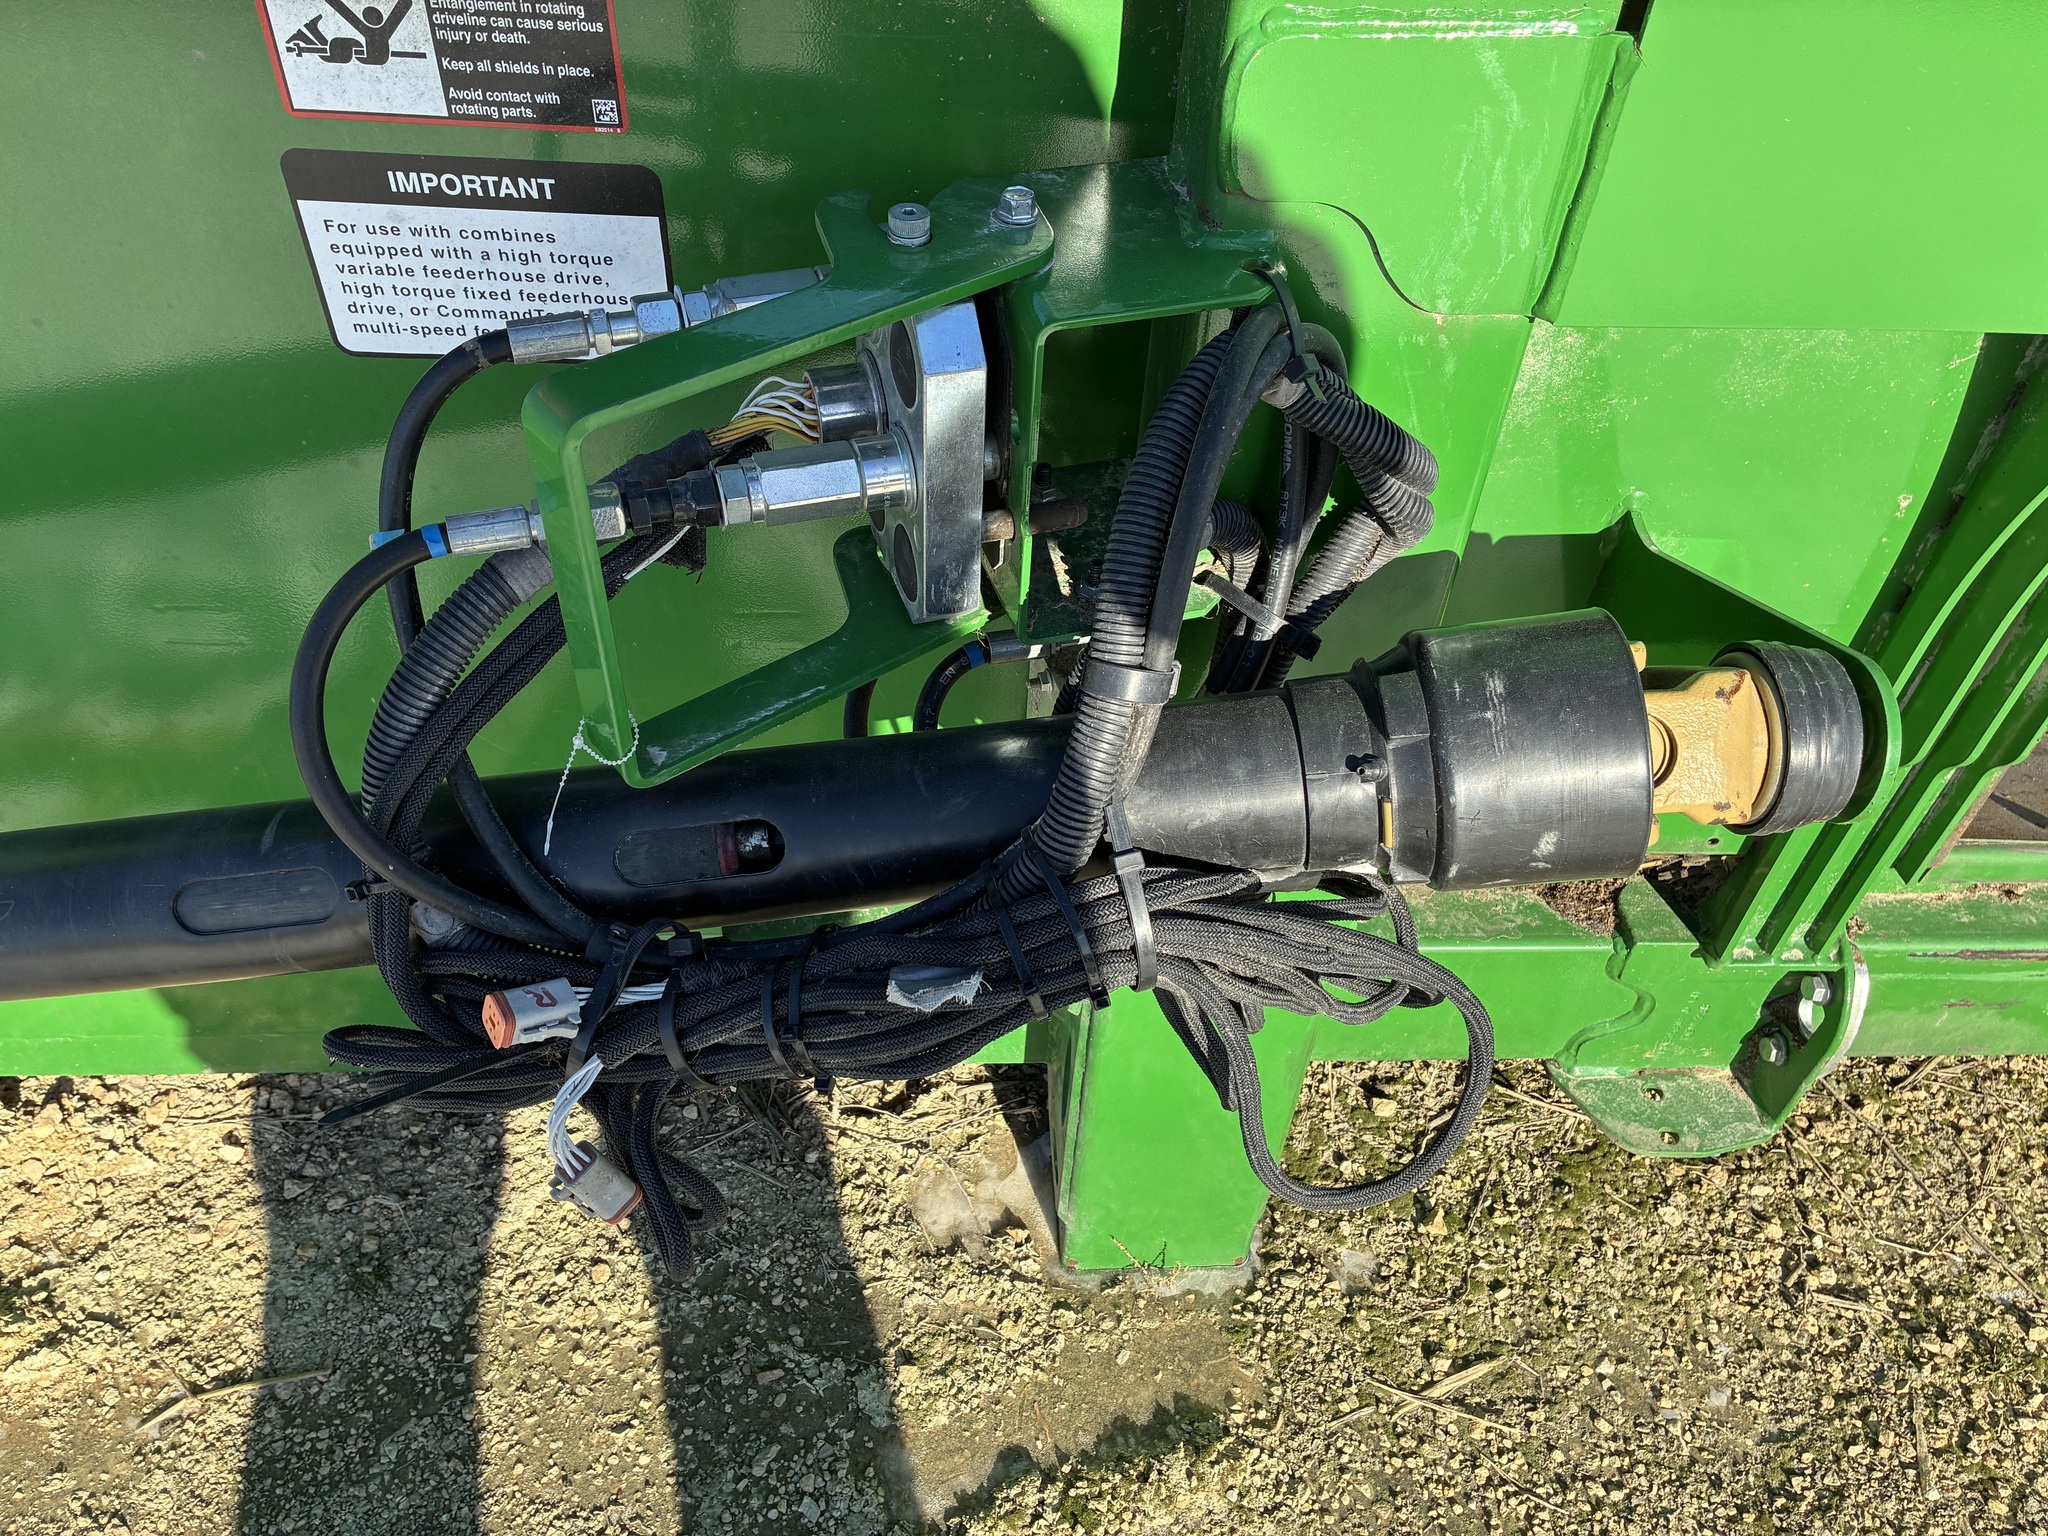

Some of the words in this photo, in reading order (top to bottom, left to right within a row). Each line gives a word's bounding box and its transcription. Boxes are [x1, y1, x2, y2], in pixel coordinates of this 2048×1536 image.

[430, 0, 517, 13] Entanglement
[520, 1, 532, 13] in
[536, 3, 585, 18] rotating
[433, 11, 487, 26] driveline
[490, 17, 513, 28] can
[516, 18, 554, 30] cause
[557, 19, 604, 33] serious
[435, 27, 472, 44] injury
[474, 32, 488, 42] or
[491, 29, 531, 44] death.
[441, 56, 474, 73] Keep
[476, 59, 491, 72] all
[495, 60, 540, 75] shields
[542, 63, 554, 75] in
[557, 64, 595, 79] place.
[449, 86, 482, 100] Avoid
[486, 91, 532, 103] contact
[534, 92, 561, 105] with
[451, 103, 499, 118] rotating
[502, 105, 537, 120] parts.
[386, 170, 556, 200] IMPORTANT
[323, 219, 357, 234] For
[365, 224, 401, 236] use
[408, 224, 451, 239] with
[459, 227, 556, 244] combines
[329, 242, 423, 260] equipped
[430, 246, 473, 260] with
[480, 250, 491, 261] a
[498, 249, 542, 266] high
[549, 251, 614, 268] torque
[335, 262, 416, 277] variable
[422, 265, 546, 283] feederhouse
[554, 271, 610, 287] drive,
[340, 281, 385, 298] high
[391, 284, 456, 301] torque
[462, 286, 512, 301] fixed
[518, 289, 628, 306] feederhous
[347, 301, 404, 318] drive,
[410, 306, 429, 317] or
[352, 321, 468, 338] multi-speed
[1278, 490, 1289, 528] AT3K
[1263, 538, 1284, 607] MINETUF
[940, 667, 957, 685] EN
